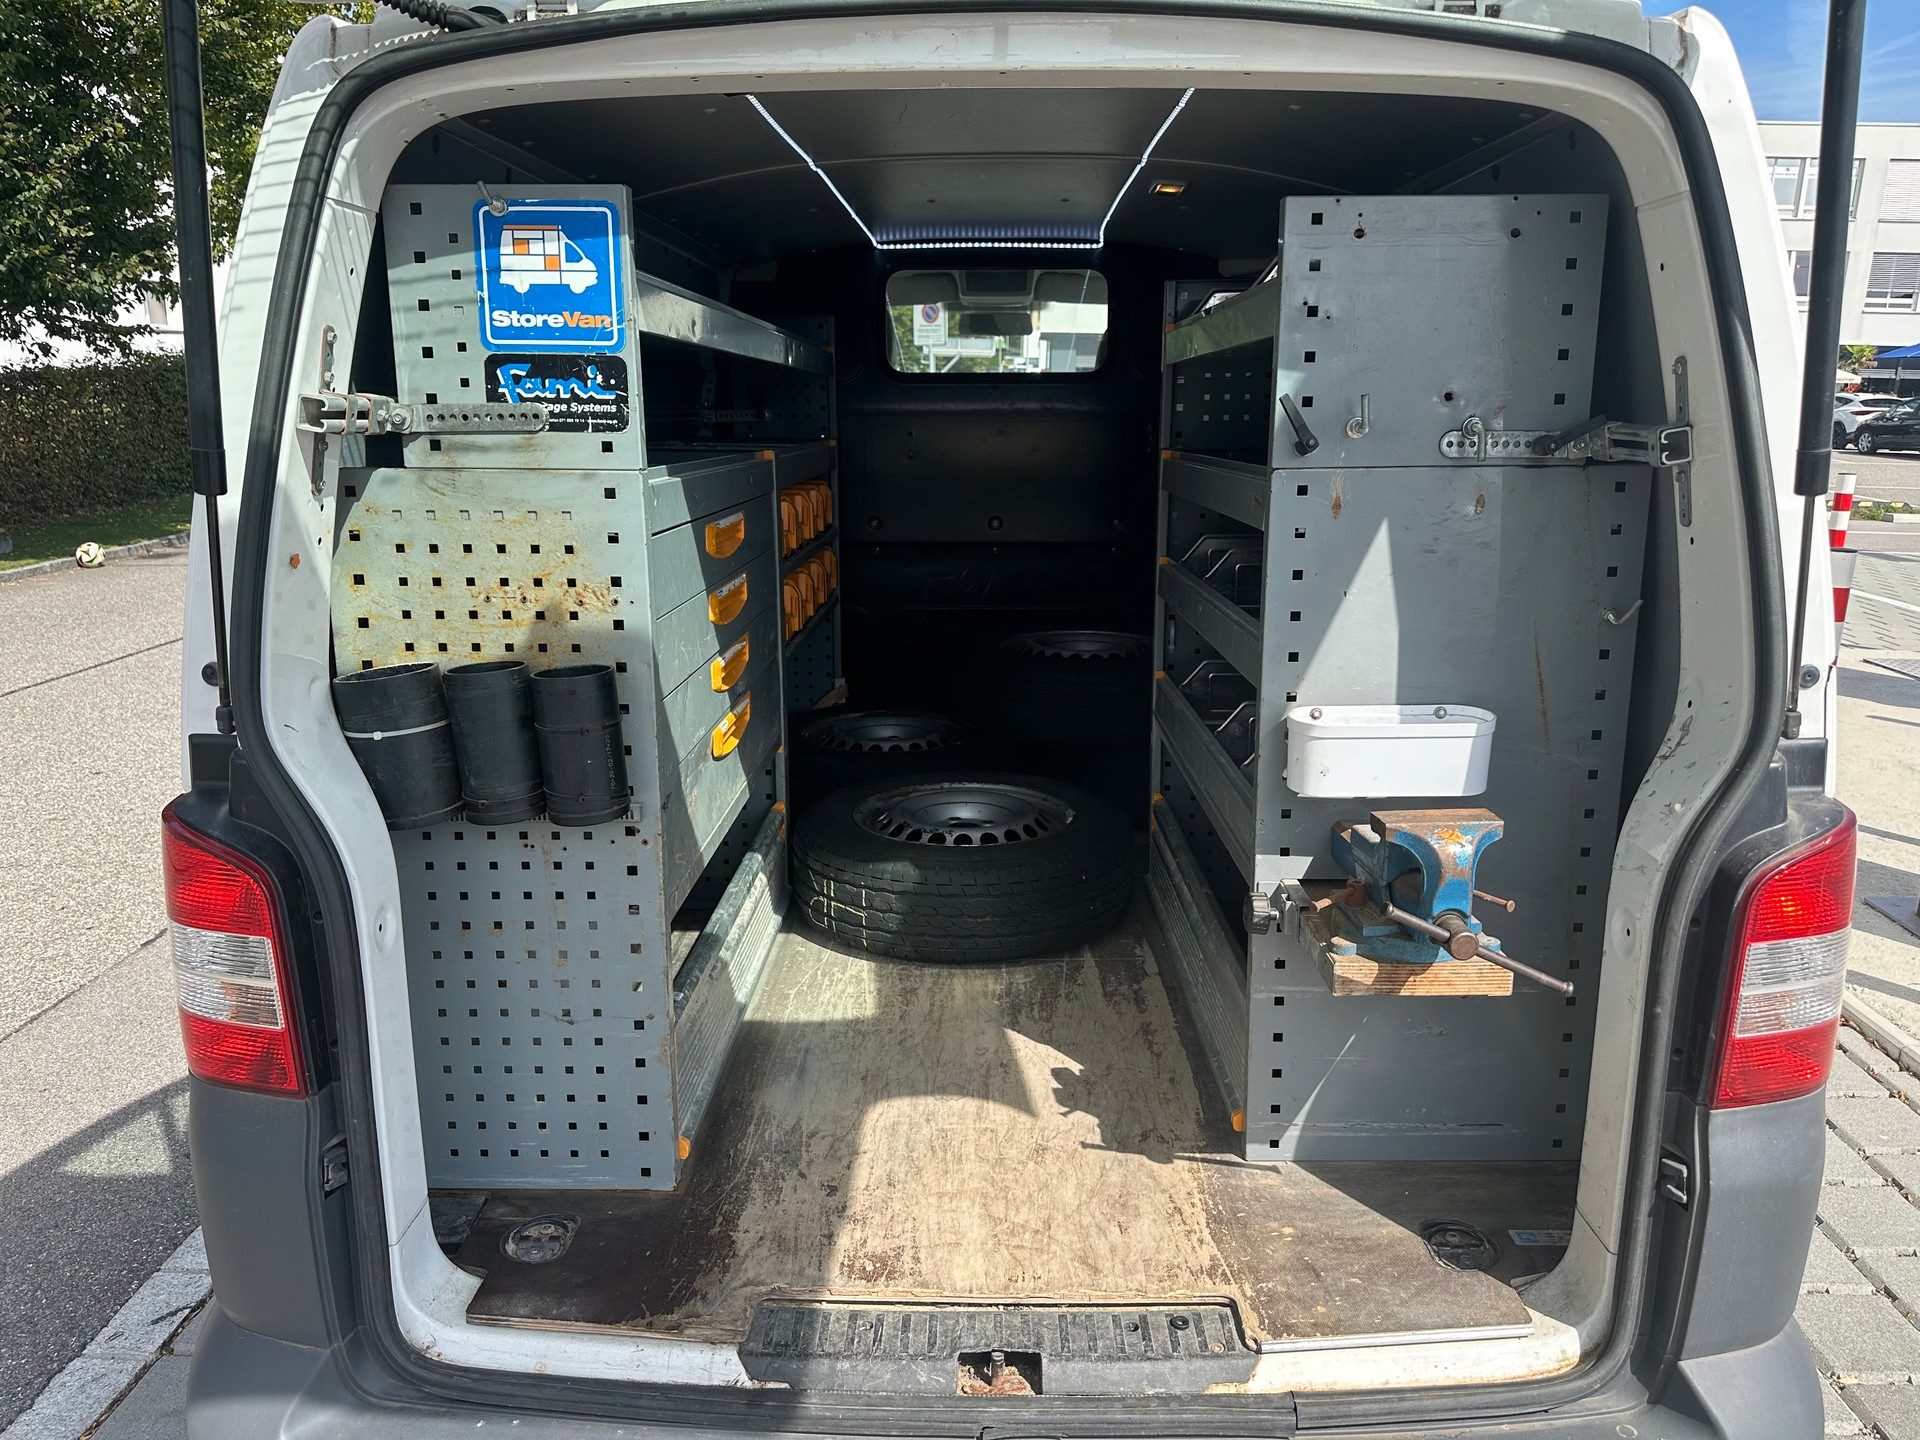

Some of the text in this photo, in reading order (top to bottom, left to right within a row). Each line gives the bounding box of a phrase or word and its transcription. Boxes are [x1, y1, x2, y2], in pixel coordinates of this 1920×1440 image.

[492, 310, 612, 328] StoreVan
[496, 363, 617, 404] Fami
[570, 402, 617, 413] Systems
